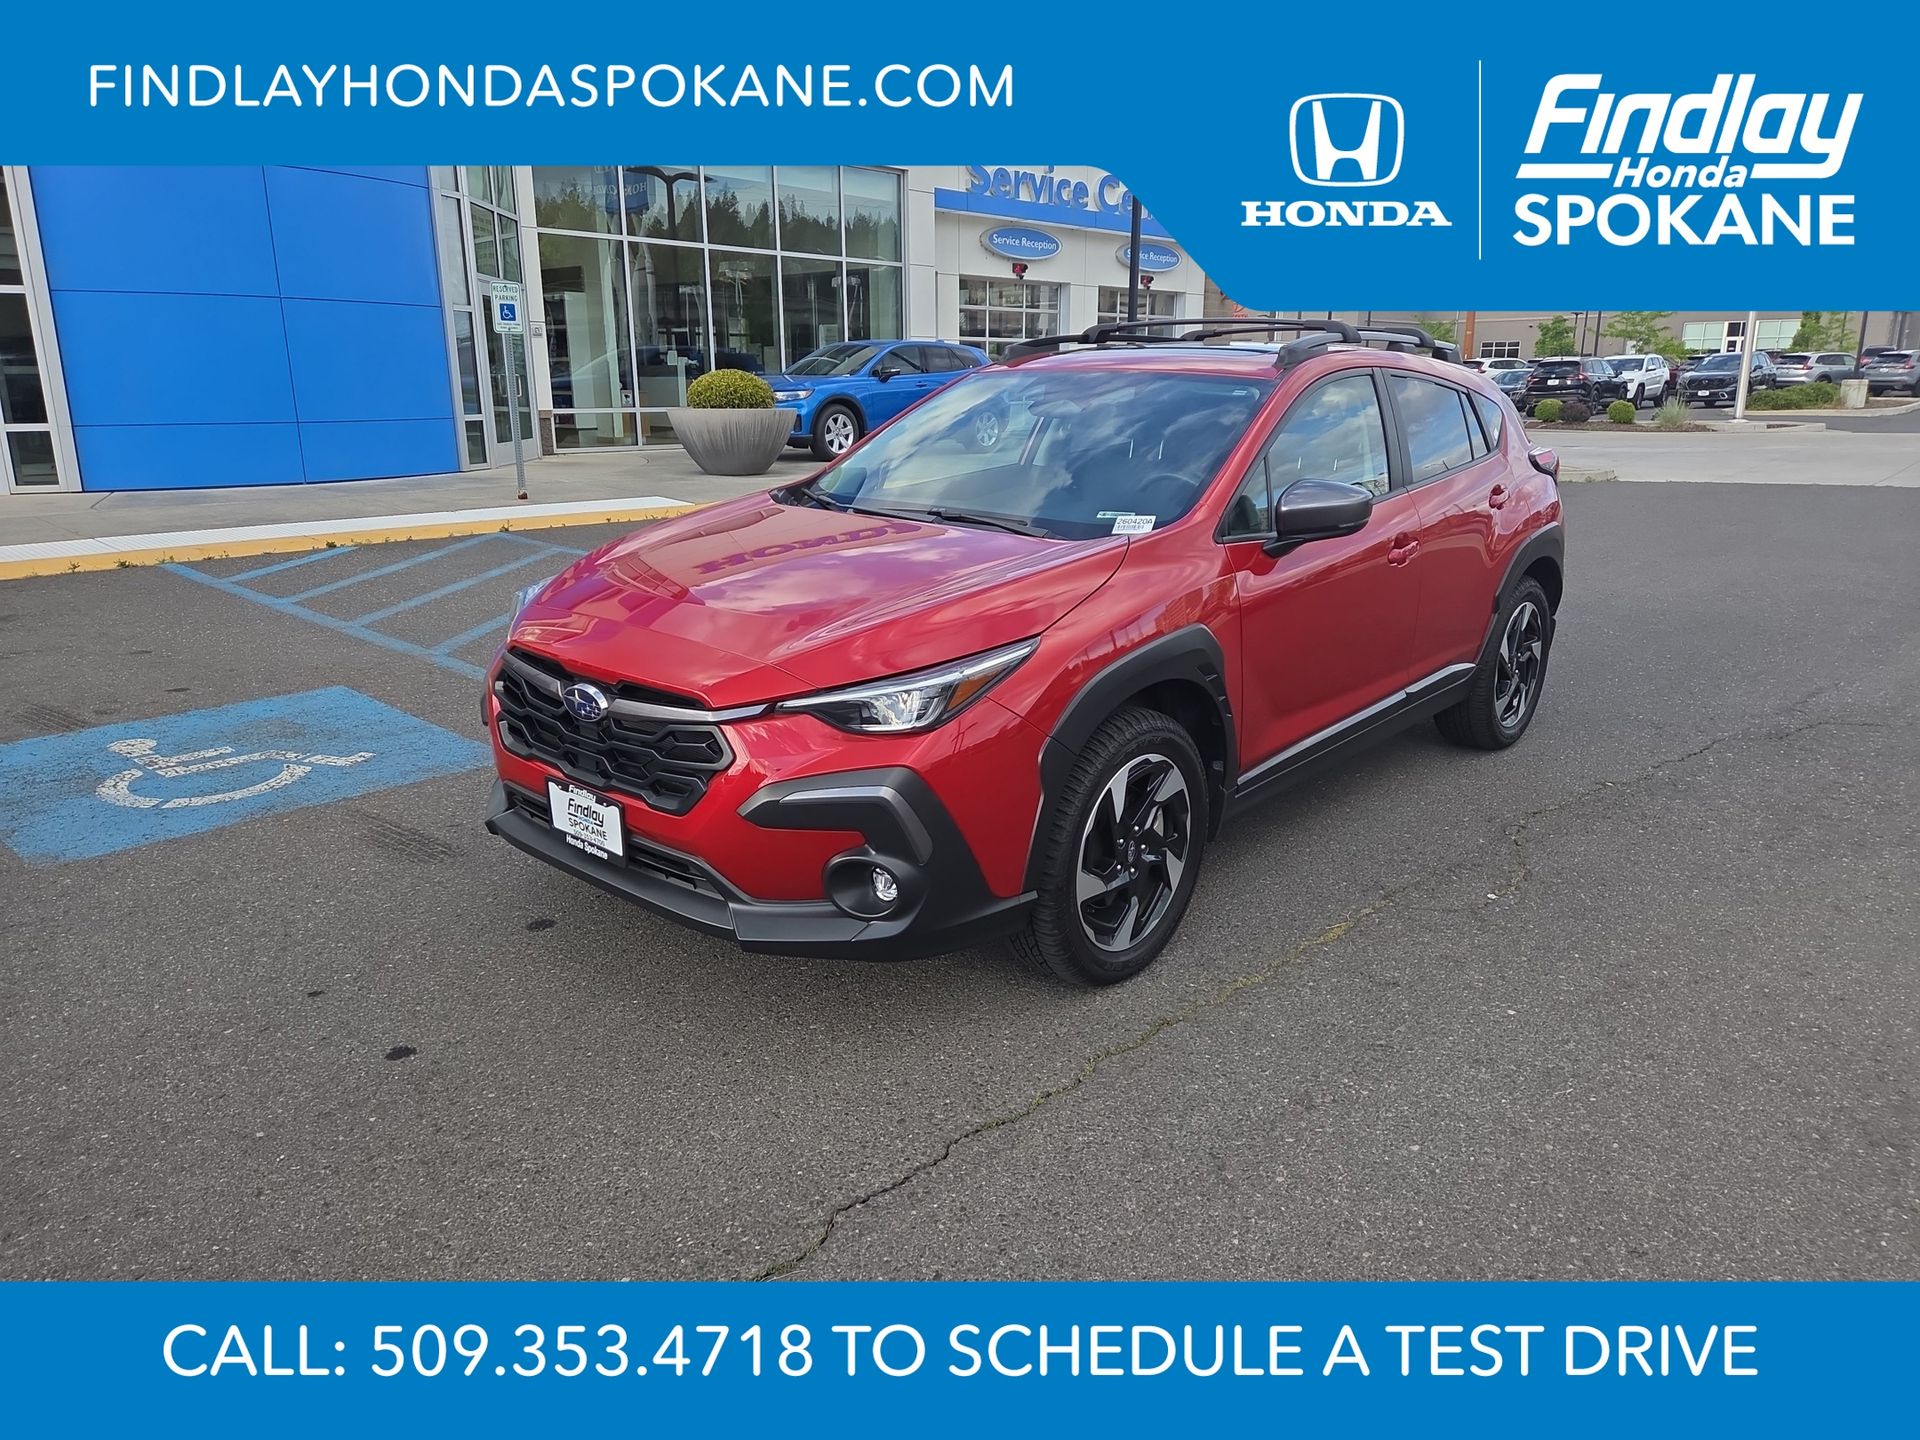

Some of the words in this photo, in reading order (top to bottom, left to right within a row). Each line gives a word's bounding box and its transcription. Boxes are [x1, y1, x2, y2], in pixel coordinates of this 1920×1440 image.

[992, 233, 1020, 246] Service
[1021, 237, 1057, 251] Reception
[1149, 251, 1178, 264] Reception
[493, 285, 519, 293] RESERVED
[495, 294, 518, 302] PARKING
[568, 798, 604, 827] Findlay
[568, 817, 608, 841] SPOKANE
[566, 834, 583, 849] Honda
[584, 842, 608, 860] Spokane
